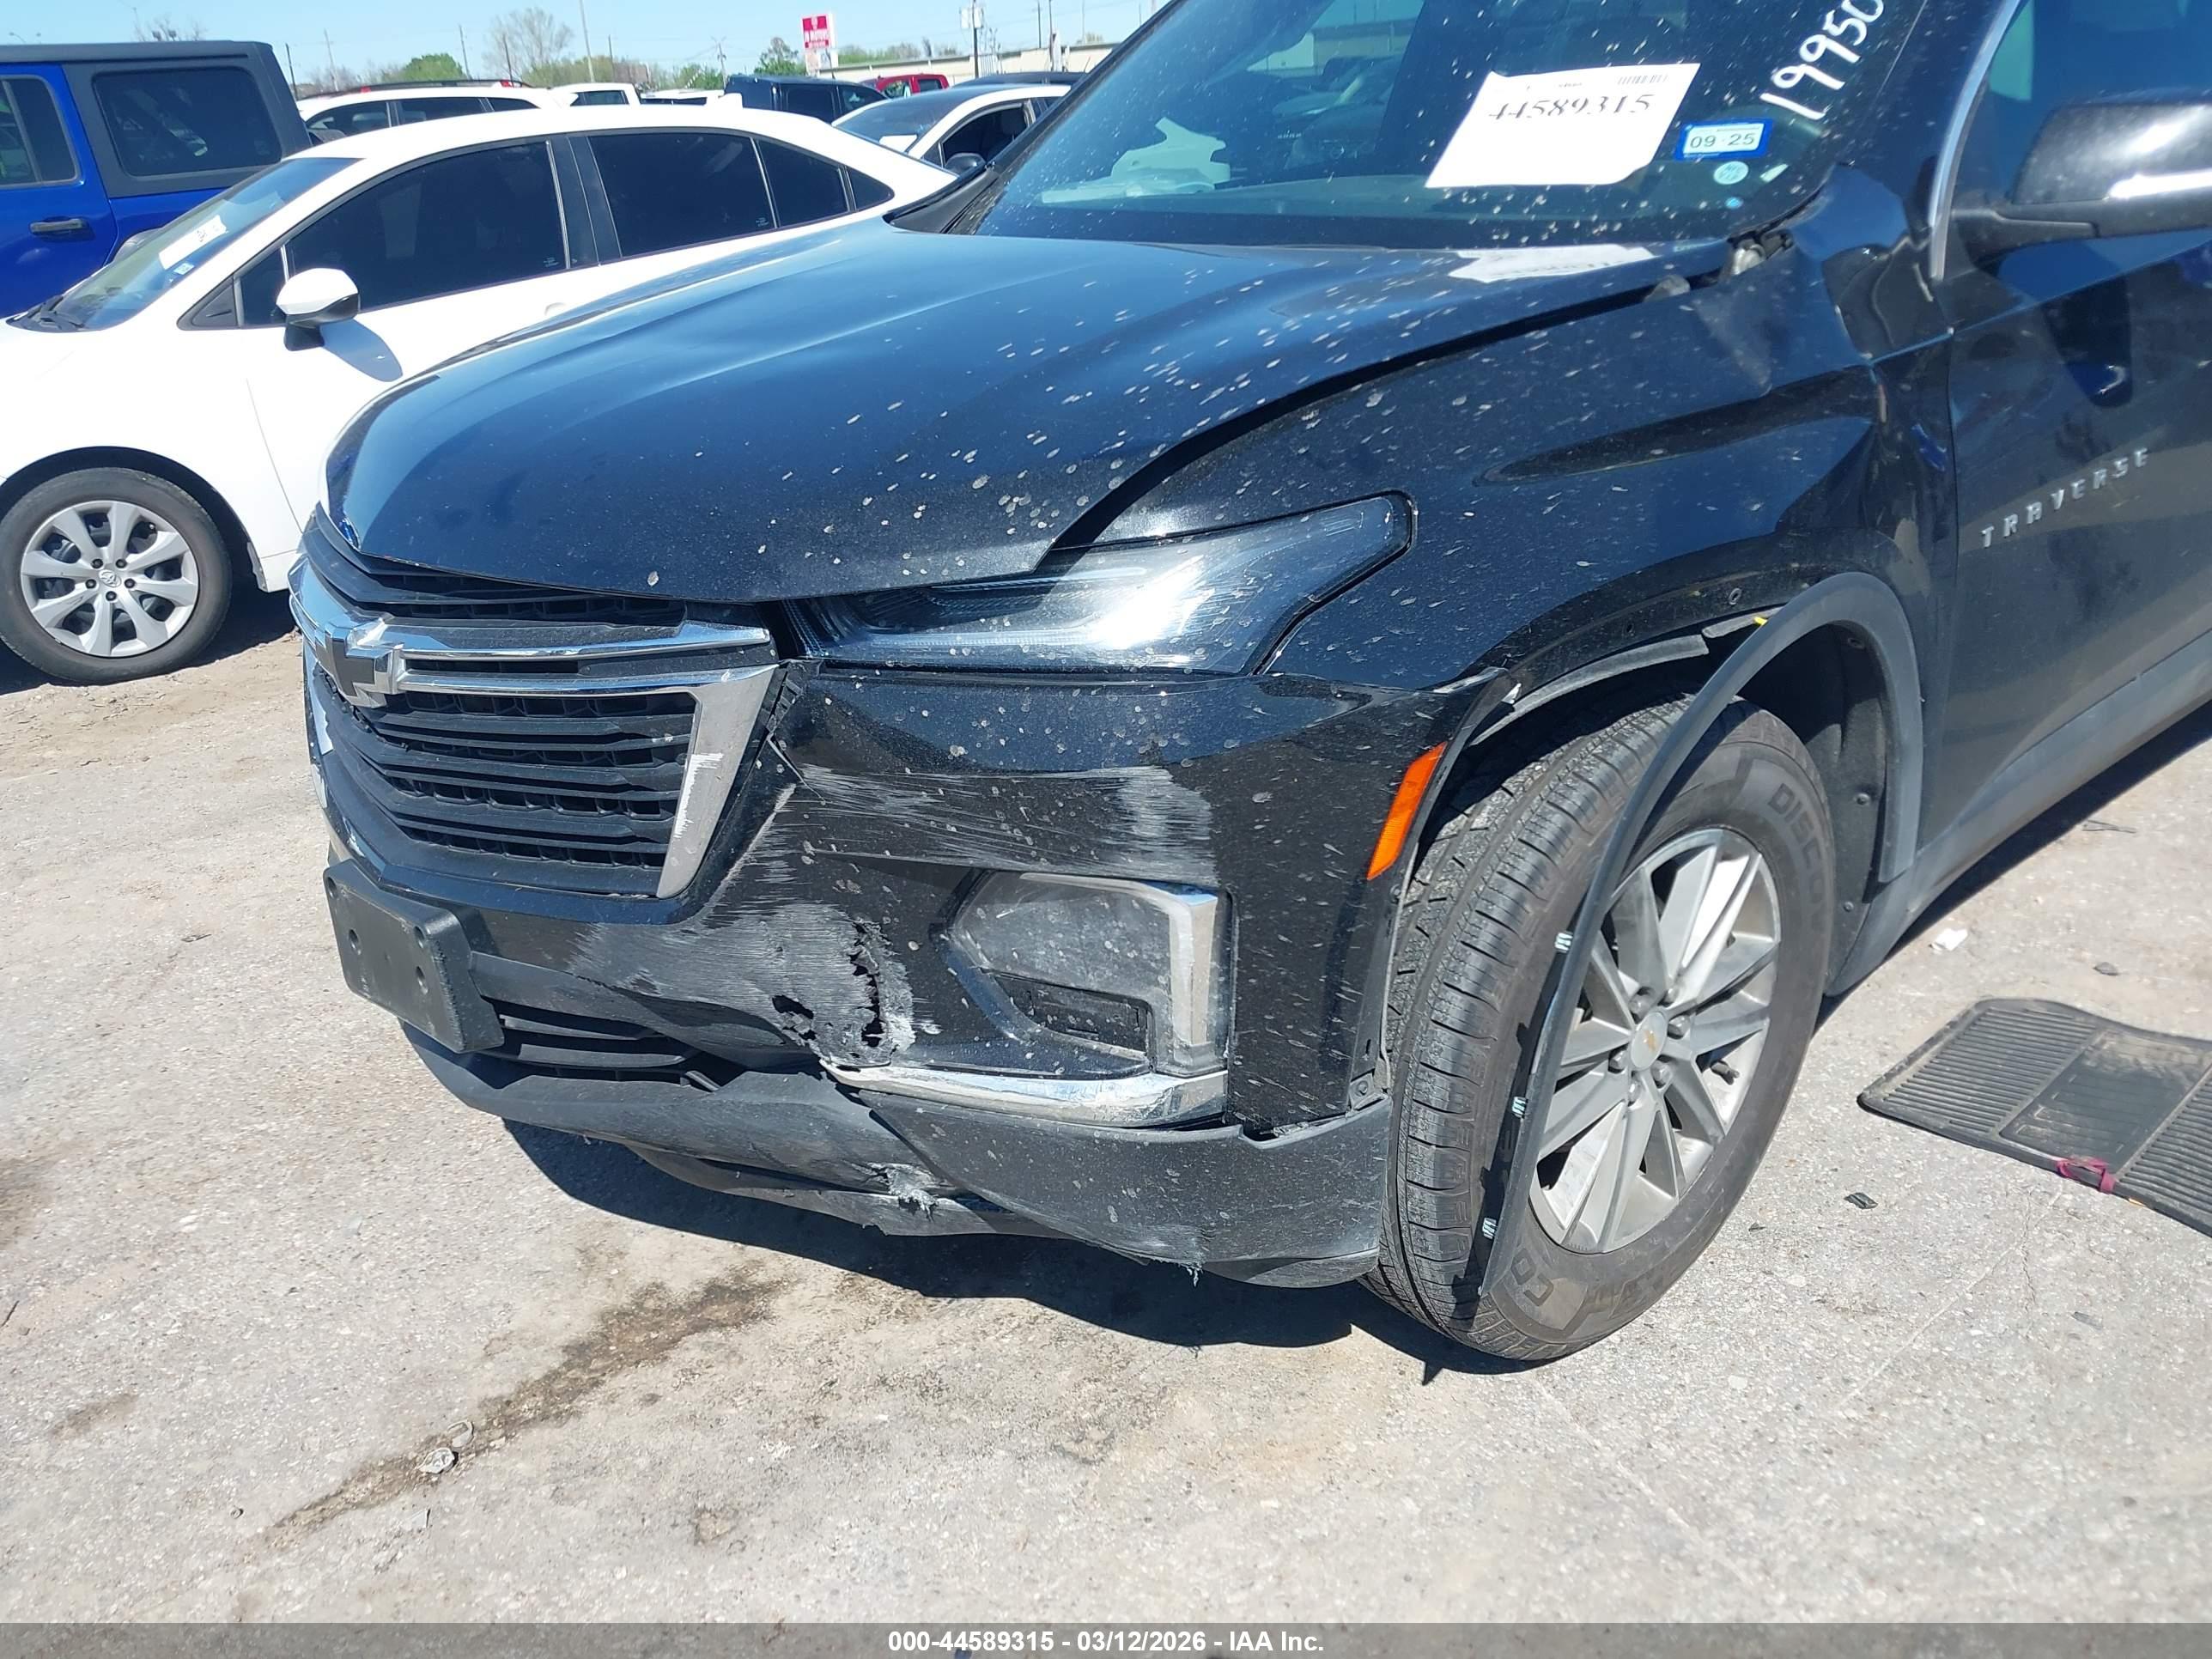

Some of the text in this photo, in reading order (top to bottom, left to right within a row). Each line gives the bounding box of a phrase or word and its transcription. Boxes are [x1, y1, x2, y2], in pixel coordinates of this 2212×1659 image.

[1488, 94, 1656, 121] 44589315
[1689, 132, 1757, 149] 09 25
[1981, 447, 2148, 548] TRAVERSE
